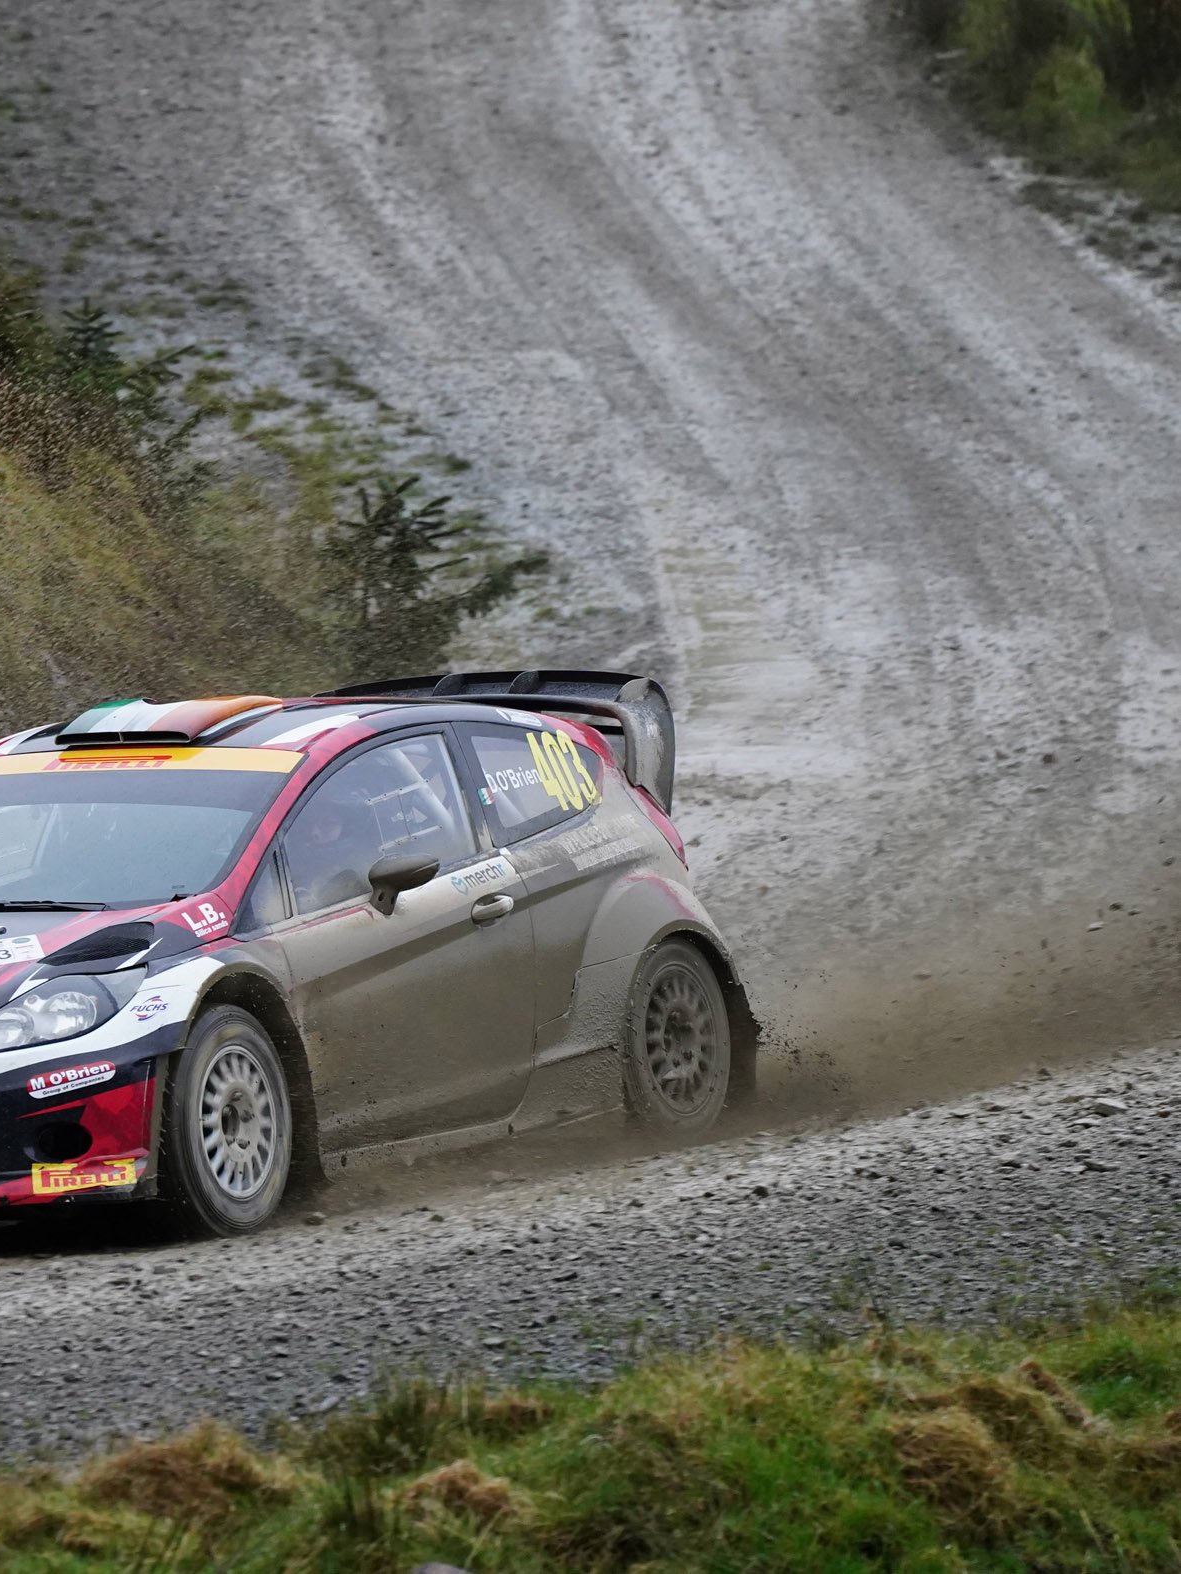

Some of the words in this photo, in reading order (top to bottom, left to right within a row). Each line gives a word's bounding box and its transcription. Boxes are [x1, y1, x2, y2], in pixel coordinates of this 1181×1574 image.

[42, 755, 173, 770] PIRELLI
[526, 729, 602, 812] 403
[486, 766, 542, 794] D.O'Brien
[464, 861, 506, 889] merchr
[181, 902, 226, 931] L.B.
[130, 1002, 168, 1013] FUCHS
[30, 1077, 46, 1091] M
[49, 1063, 111, 1085] O'Brien
[40, 1165, 127, 1188] PIRELLI
